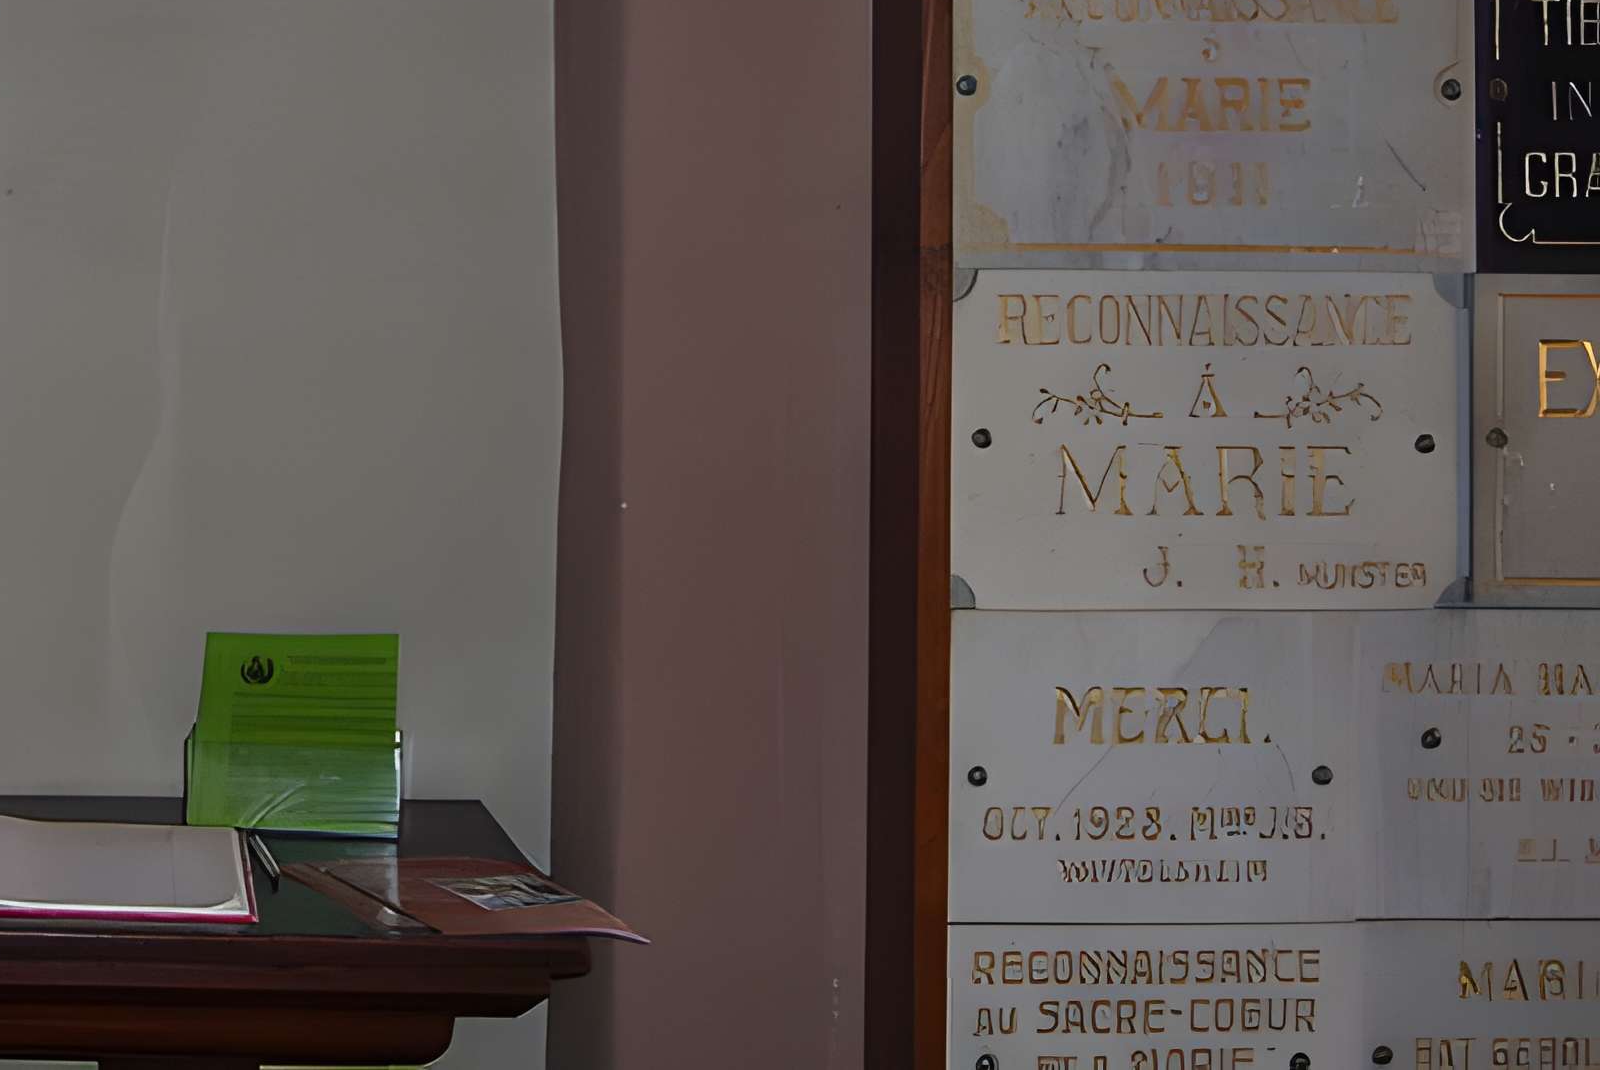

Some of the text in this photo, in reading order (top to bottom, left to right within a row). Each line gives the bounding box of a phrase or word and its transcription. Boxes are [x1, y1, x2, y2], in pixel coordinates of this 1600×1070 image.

[1103, 63, 1312, 132] MARIE
[995, 292, 1413, 347] RECONNAISSANCE
[1055, 441, 1357, 520] MARIE
[971, 948, 1321, 986] RECONNAISSANCE
[973, 1005, 1021, 1036] AU
